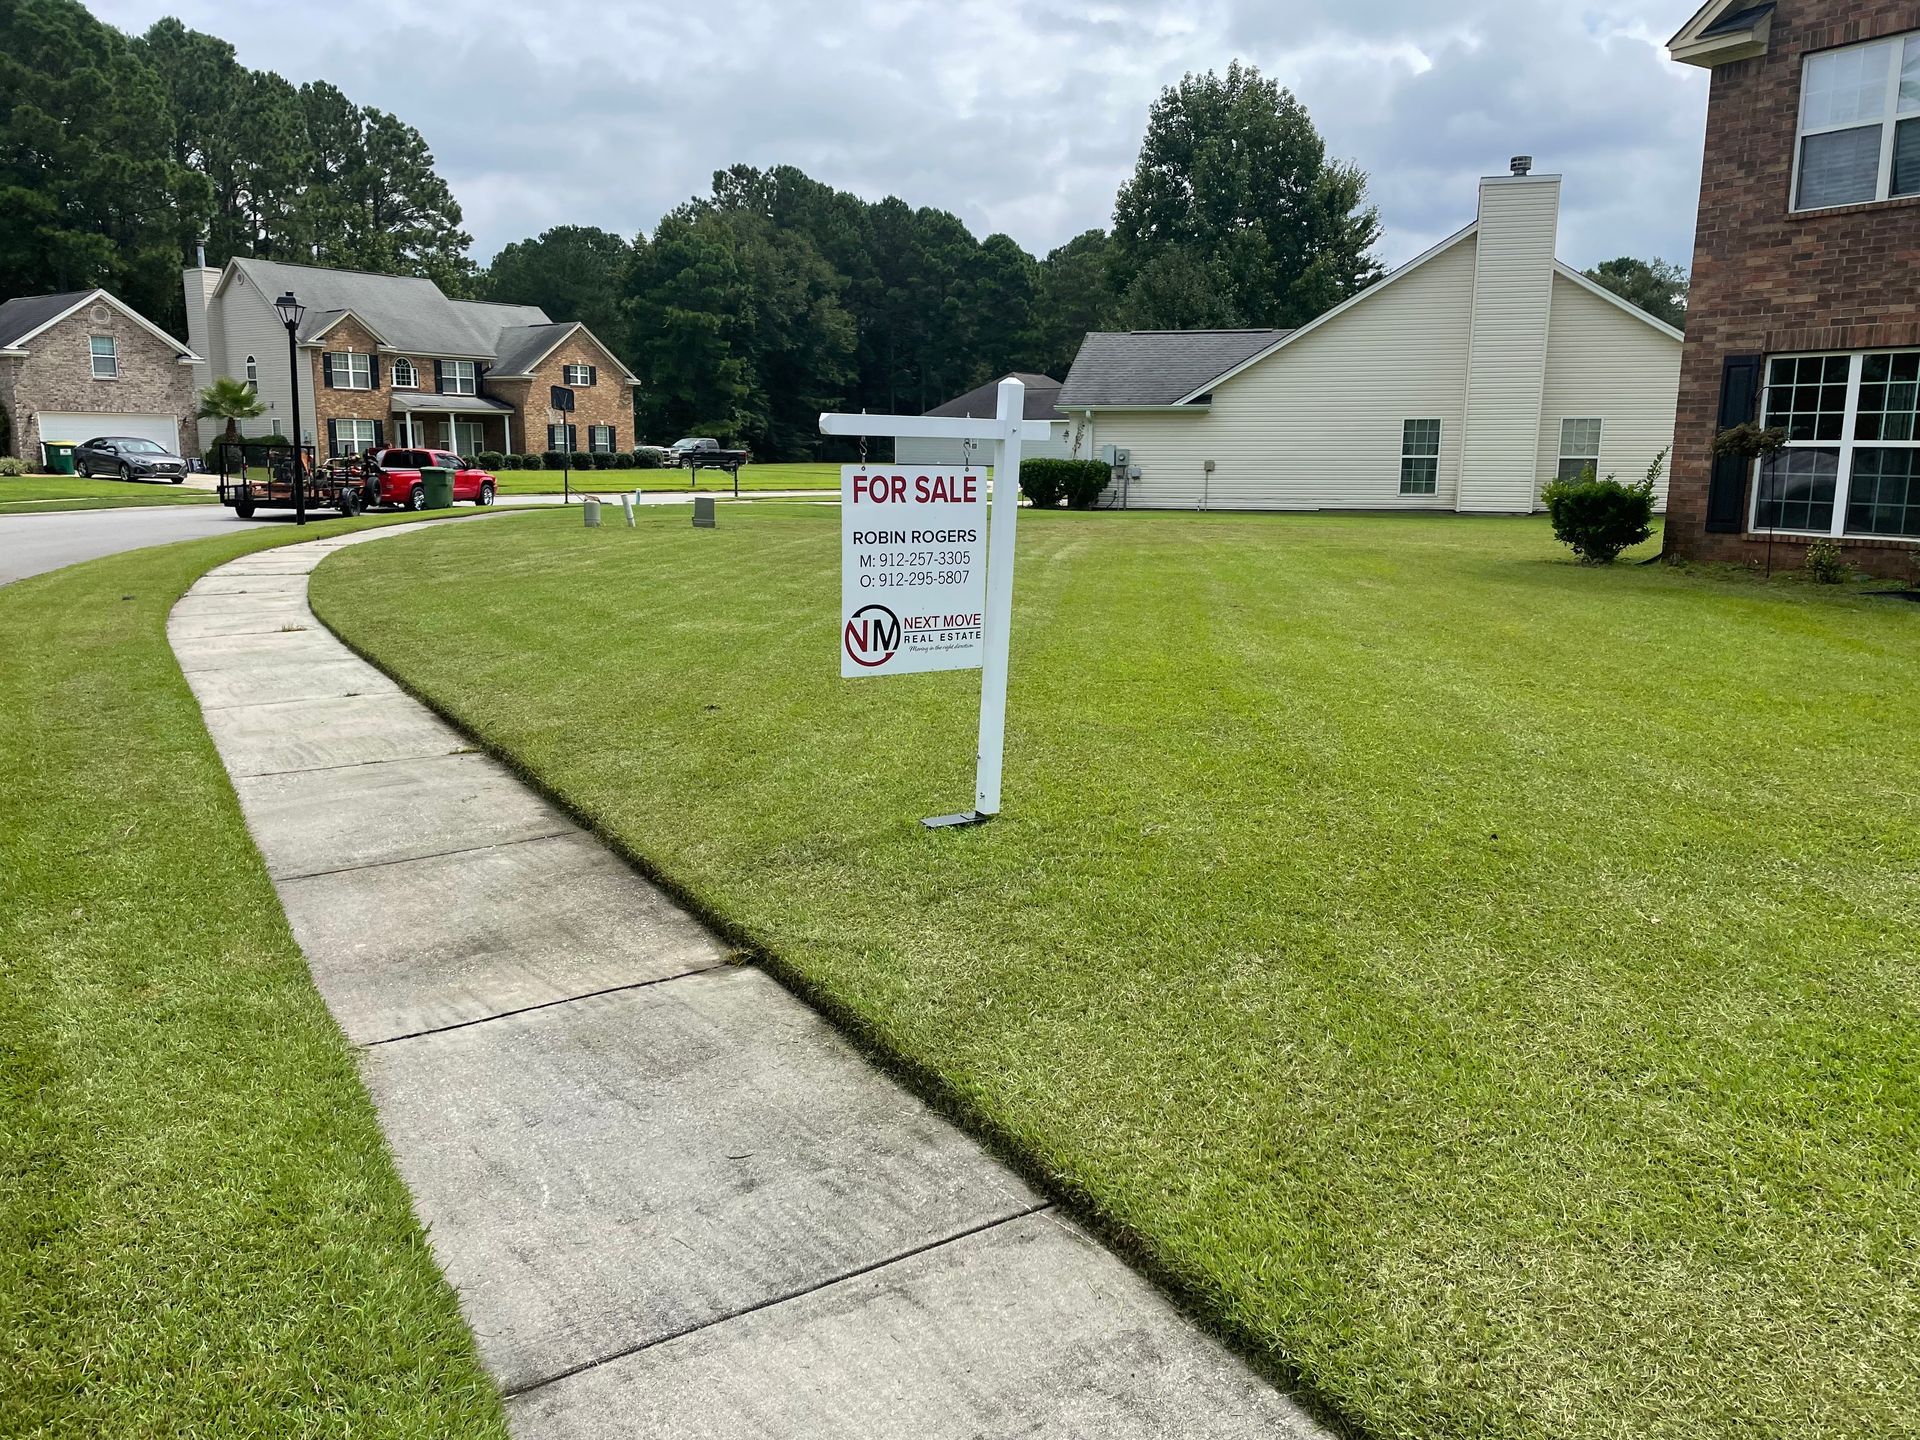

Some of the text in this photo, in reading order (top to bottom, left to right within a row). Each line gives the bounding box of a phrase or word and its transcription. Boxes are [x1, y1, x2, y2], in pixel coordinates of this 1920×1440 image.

[853, 475, 977, 504] FOR SALE
[853, 529, 977, 545] ROBIN ROGERS
[860, 550, 971, 568] M: 912-257-3305
[860, 570, 970, 588] O: 912-295-5807
[904, 613, 981, 630] NEXT MOVE
[904, 631, 981, 644] REAL ESTATE
[909, 645, 928, 654] Moving
